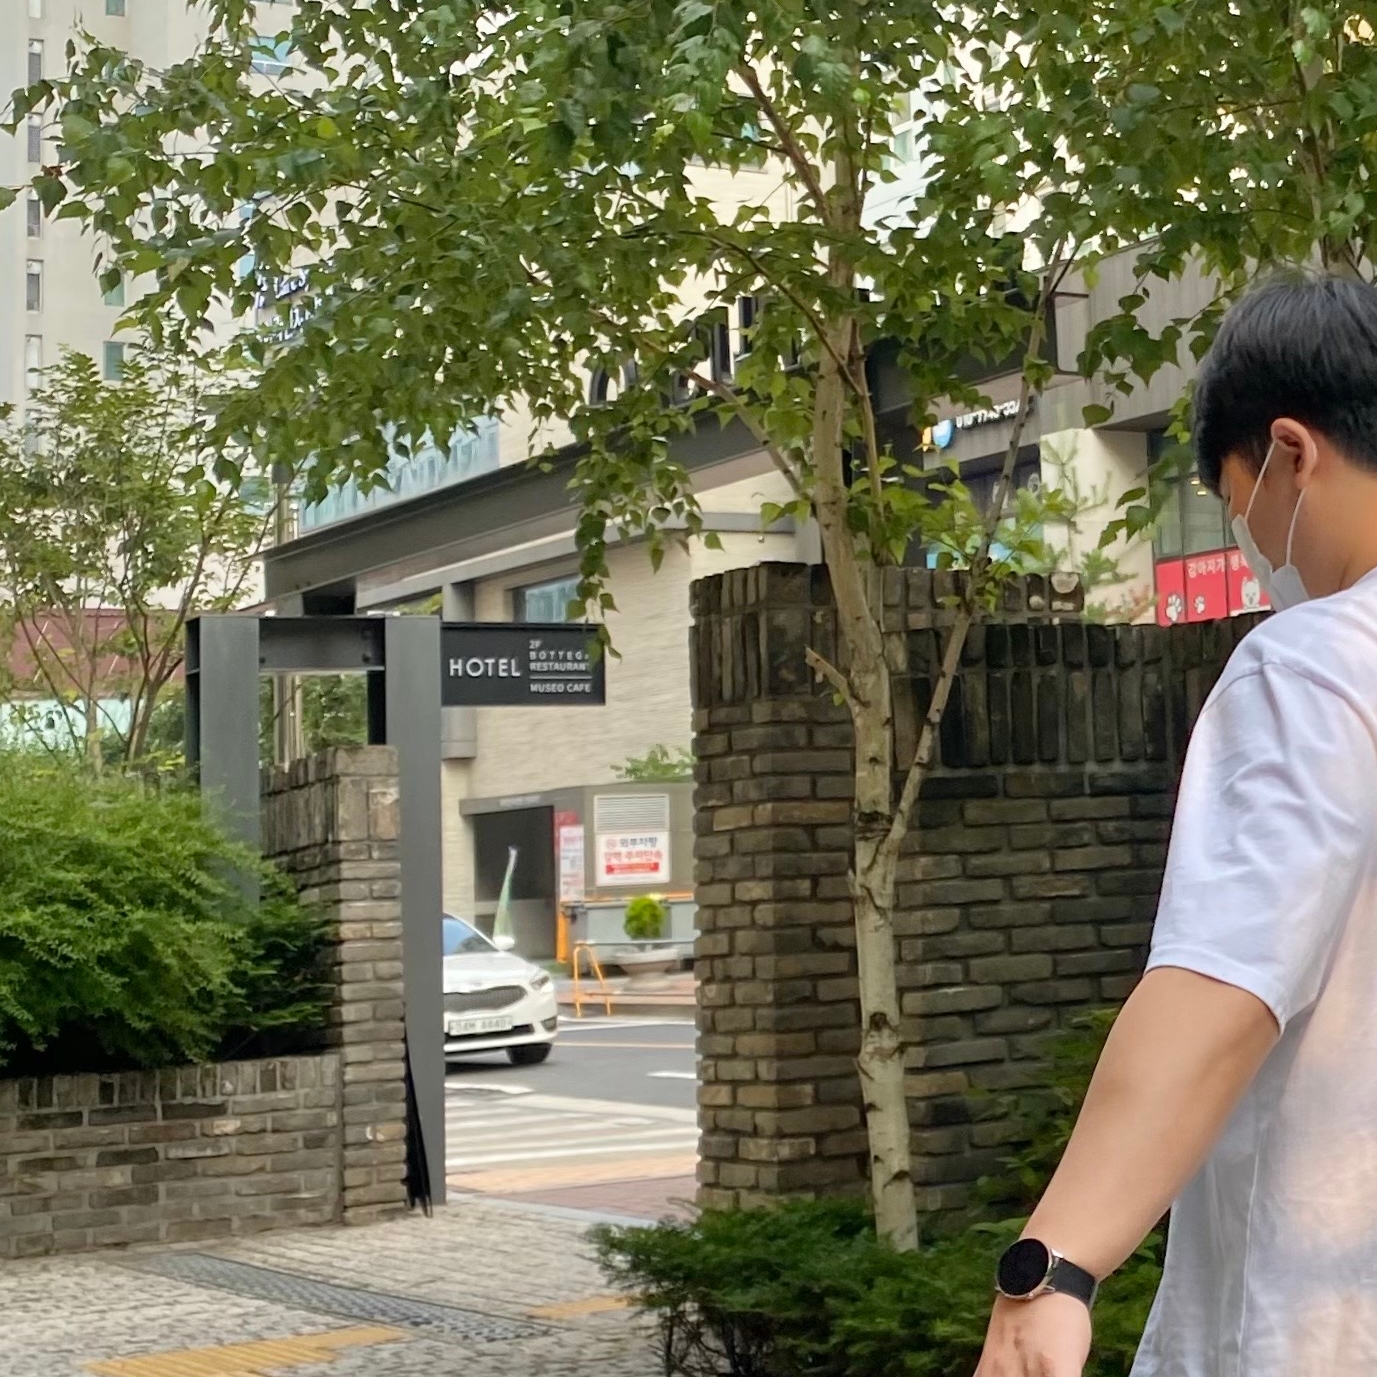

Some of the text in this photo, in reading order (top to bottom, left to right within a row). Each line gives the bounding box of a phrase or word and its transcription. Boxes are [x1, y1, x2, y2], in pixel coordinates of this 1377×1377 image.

[1188, 558, 1225, 578] 강아지가
[529, 640, 542, 650] 2F
[450, 657, 521, 677] HOTEL
[530, 683, 591, 693] MUSEO CAFE
